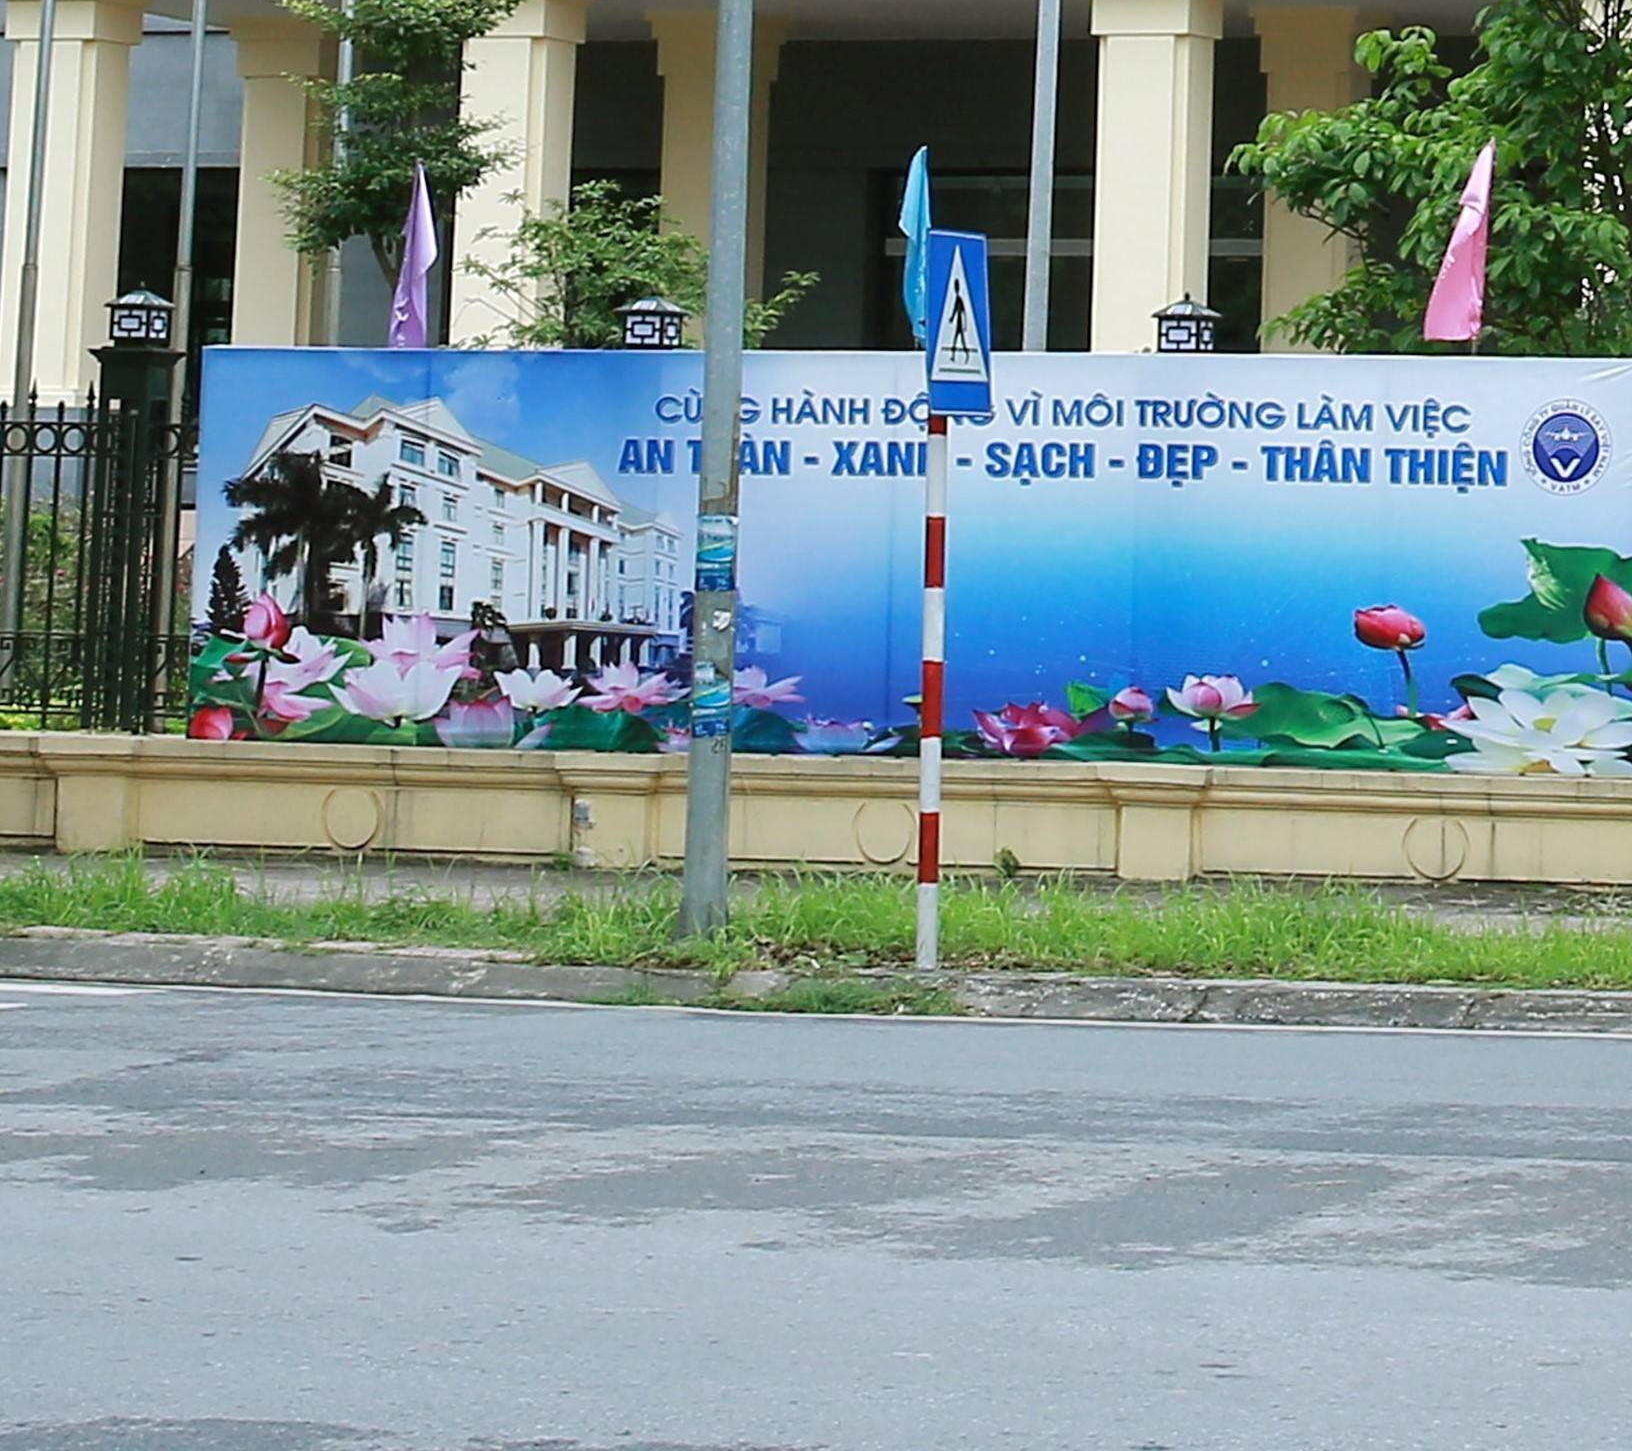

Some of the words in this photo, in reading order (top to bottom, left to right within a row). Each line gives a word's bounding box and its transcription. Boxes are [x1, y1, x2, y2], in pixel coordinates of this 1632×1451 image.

[655, 388, 761, 424] CÙG
[771, 389, 868, 425] HÀNH
[1006, 390, 1041, 426] VÌ
[1053, 393, 1125, 427] MÔI
[1136, 392, 1286, 431] TRƯỜNG
[1297, 394, 1374, 433] LÀM
[1385, 396, 1472, 439] VIỆC
[618, 439, 674, 474] AN
[686, 433, 791, 475] TÀN
[985, 441, 1095, 486] SẠCH
[1137, 443, 1217, 487] ĐẸP
[1261, 440, 1369, 484] THÂN
[1385, 443, 1508, 494] THIỆN
